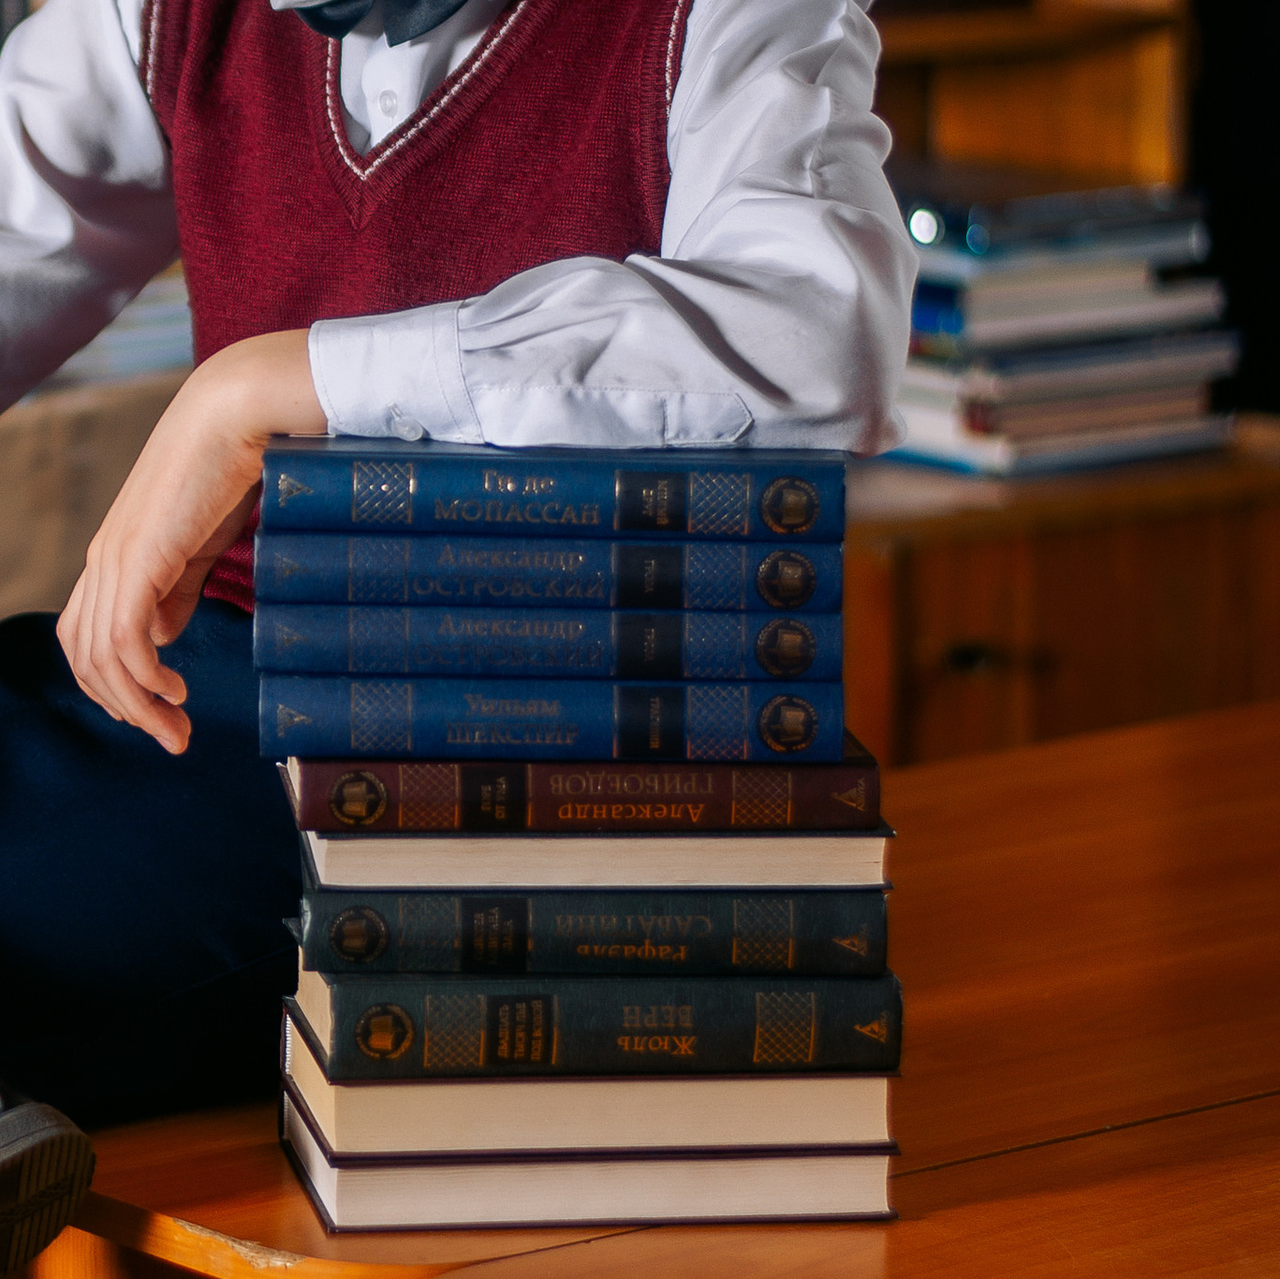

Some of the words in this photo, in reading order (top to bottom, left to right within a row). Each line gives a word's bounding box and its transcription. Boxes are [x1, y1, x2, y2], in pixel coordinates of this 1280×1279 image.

[521, 476, 555, 496] де
[433, 498, 602, 526] МОПАССАН
[436, 544, 585, 572] Александр
[412, 571, 606, 600] ОСТРОВСКИЙ
[436, 613, 586, 641] Александр
[412, 640, 604, 669] ОСТРОВСКИЙ
[463, 693, 562, 717] Уильям
[445, 721, 580, 746] ШЕКСПИР
[549, 771, 715, 795] ГРИБОЕДОВ
[557, 802, 706, 824] Александр
[555, 914, 713, 939] САБАТИНИ
[575, 940, 690, 962] Рафаэль
[621, 1004, 693, 1029] ВЕРН
[616, 1033, 698, 1055] Жюль
